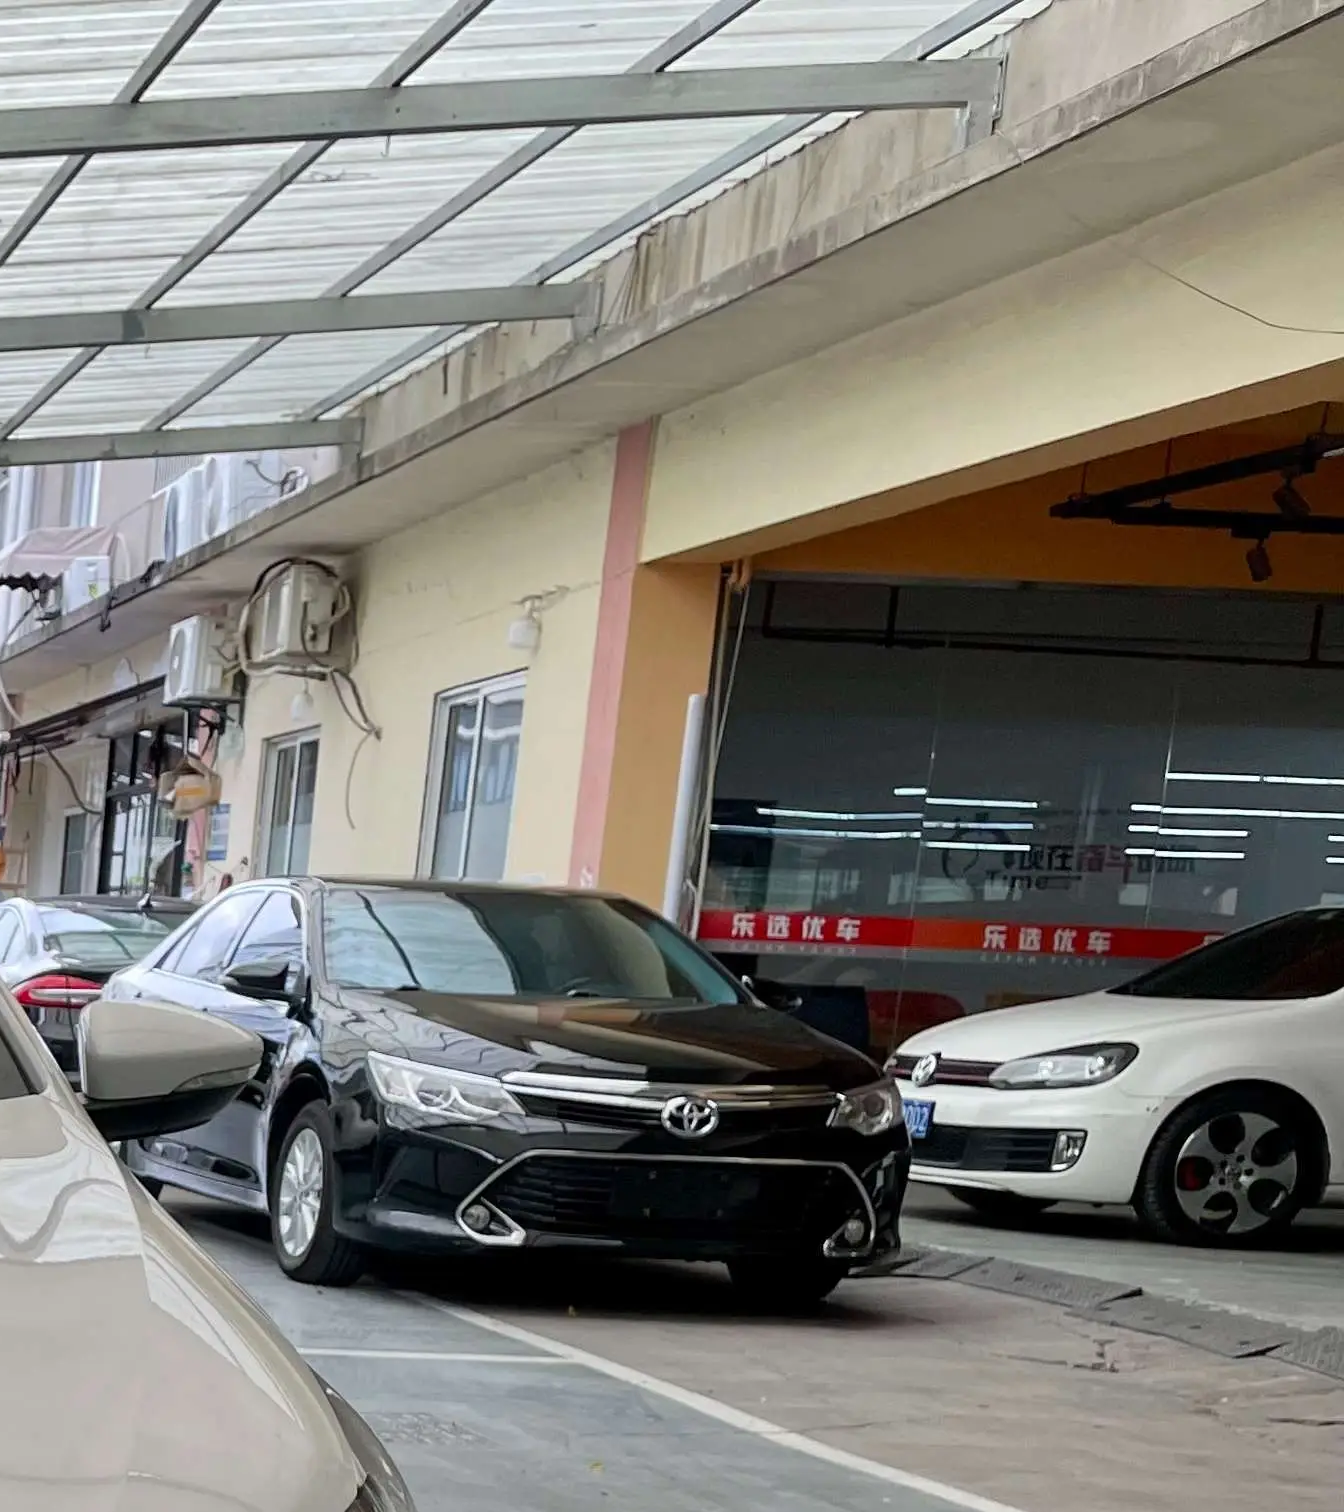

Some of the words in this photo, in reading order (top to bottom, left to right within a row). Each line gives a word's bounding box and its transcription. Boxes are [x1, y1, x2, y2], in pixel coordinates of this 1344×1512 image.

[731, 912, 861, 941] 乐选优车
[982, 923, 1112, 955] 乐选优车
